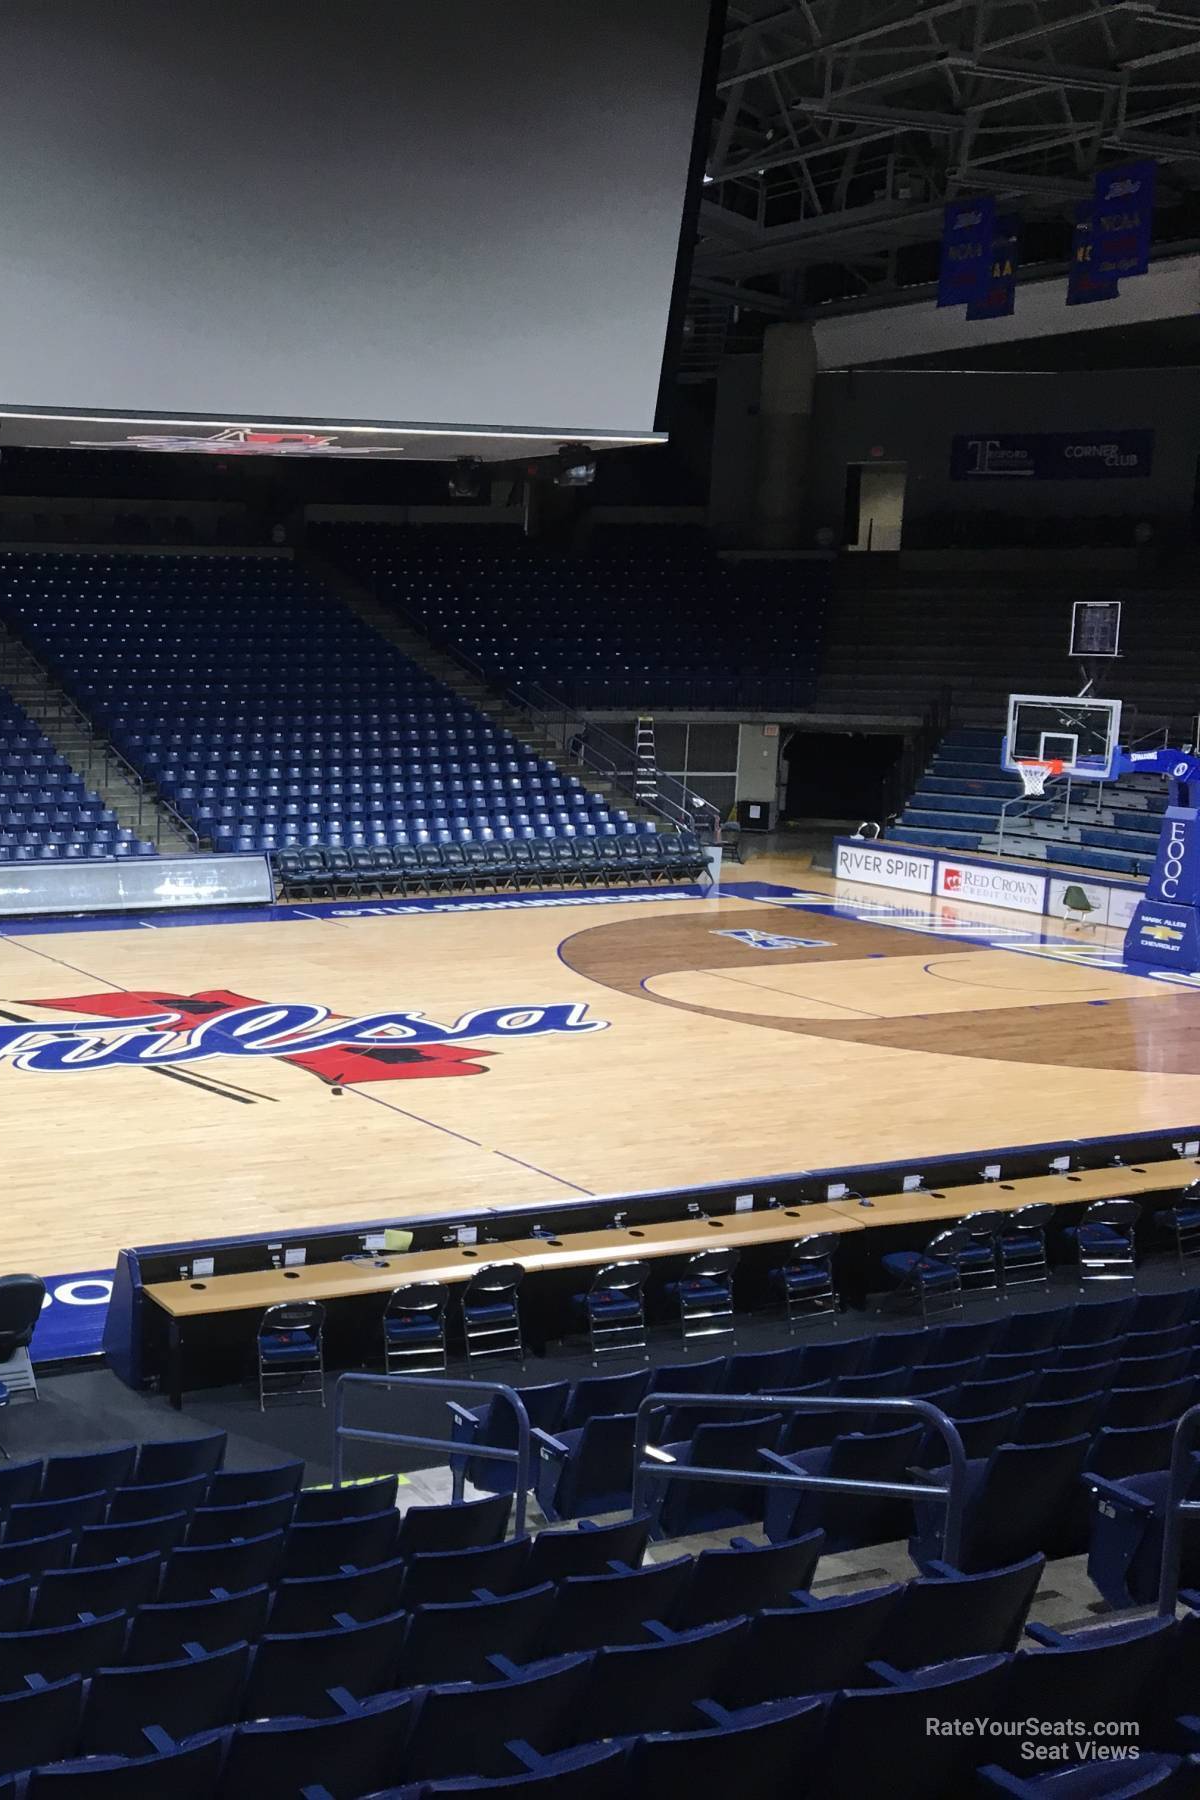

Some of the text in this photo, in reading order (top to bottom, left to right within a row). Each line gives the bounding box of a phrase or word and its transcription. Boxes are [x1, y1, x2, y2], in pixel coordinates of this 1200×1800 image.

[1064, 444, 1119, 458] CORNER
[1104, 453, 1138, 467] CLUB
[840, 851, 930, 880] RIVER SPIRIT
[964, 871, 1038, 896] RED CROWN
[1163, 920, 1187, 928] ALLEN
